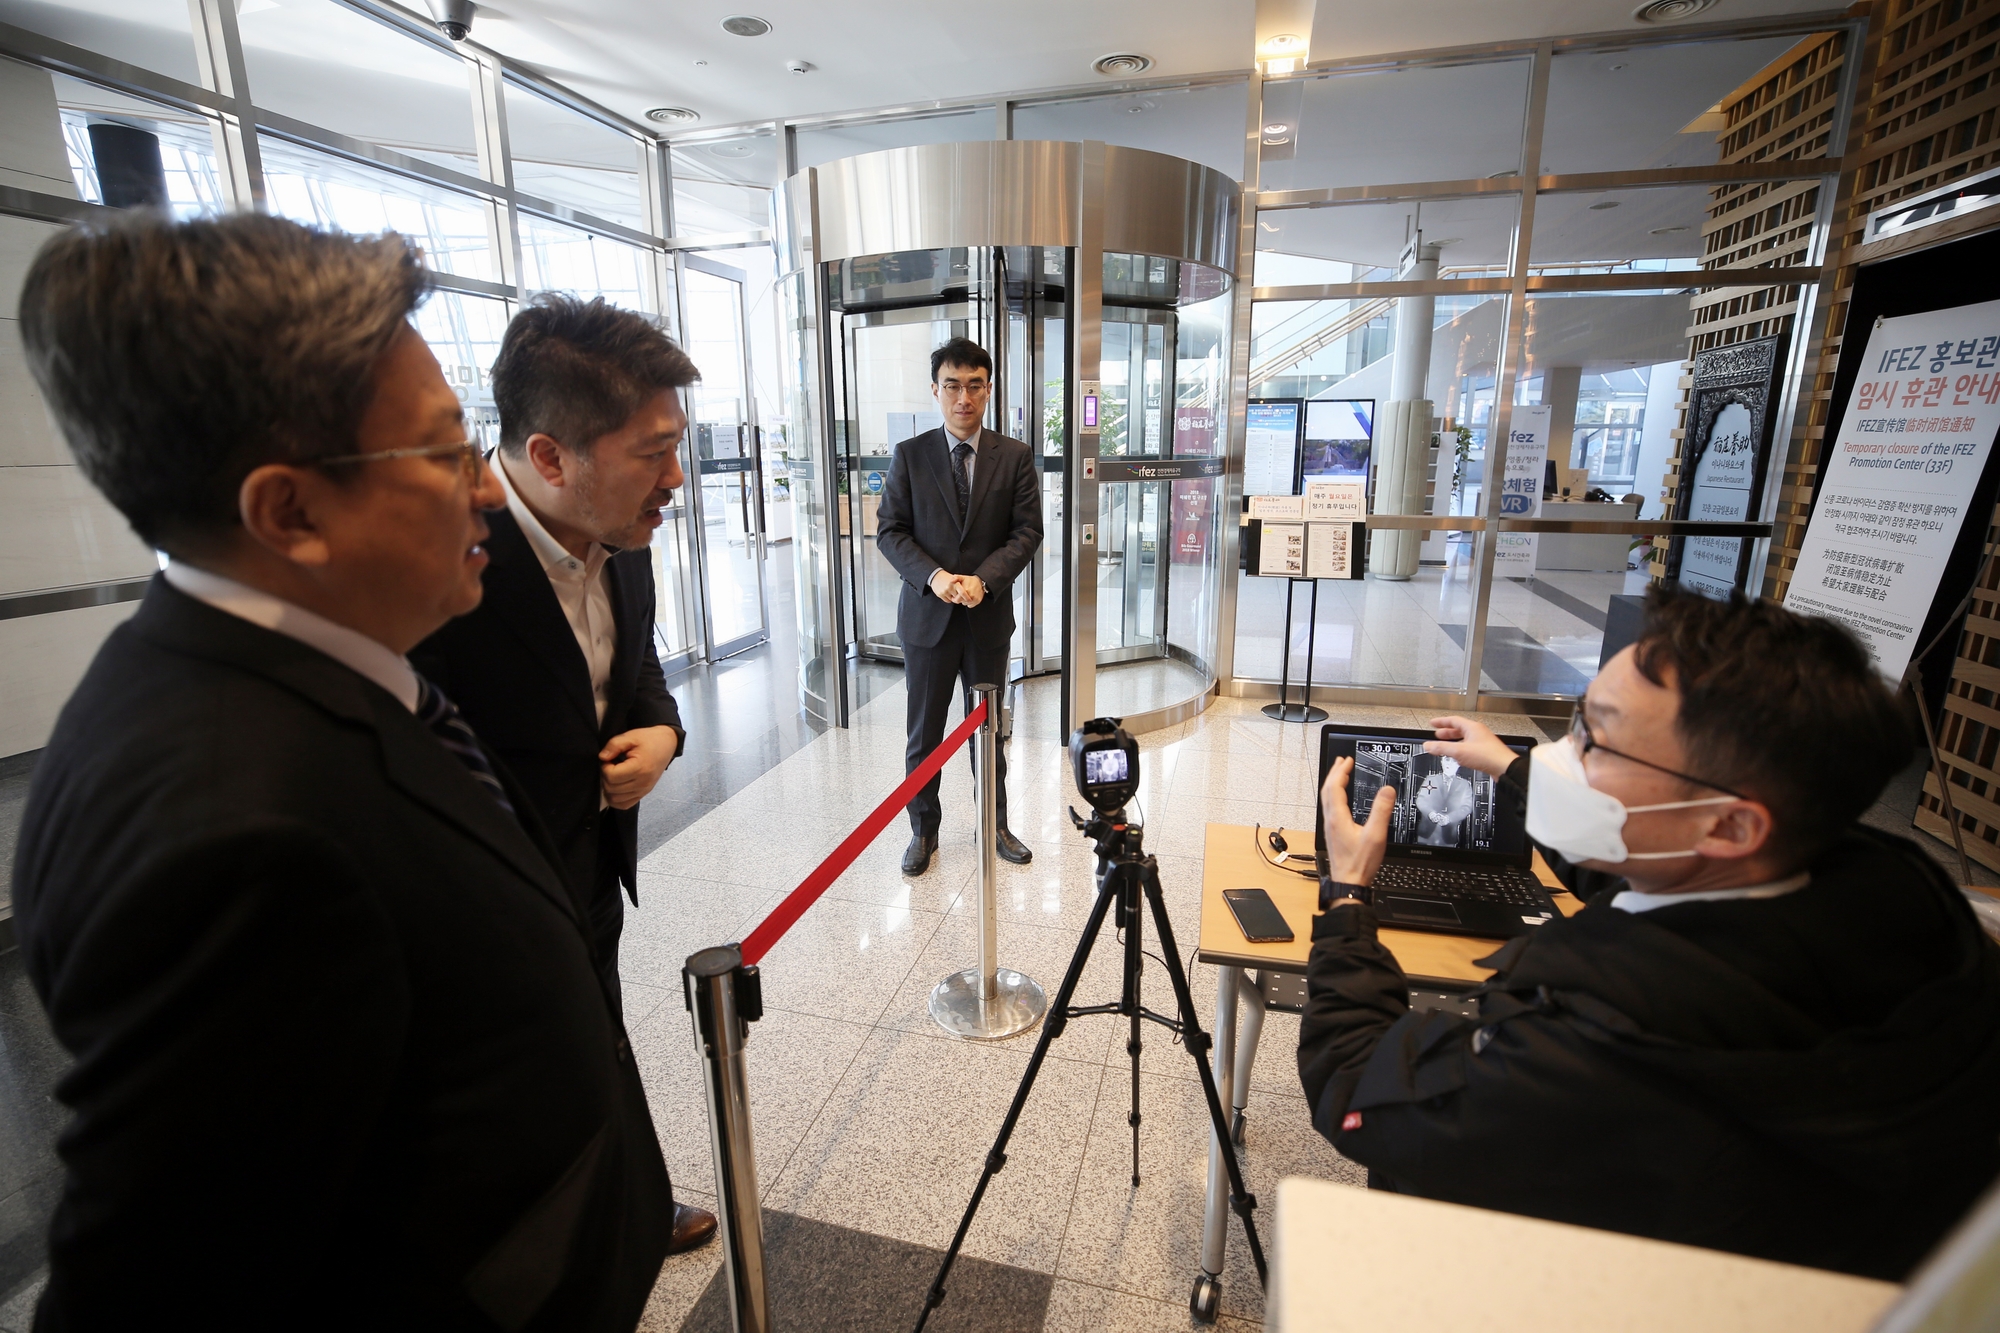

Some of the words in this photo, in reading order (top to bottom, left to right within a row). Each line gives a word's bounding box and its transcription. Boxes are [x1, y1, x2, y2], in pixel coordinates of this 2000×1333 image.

[1878, 345, 1927, 373] IFEZ
[1930, 335, 2000, 373] 홍보관
[1857, 380, 1899, 410] 임시
[1902, 377, 1948, 409] 휴관
[1953, 372, 2000, 406] 안내
[1856, 416, 1975, 433] IFEZ宣传馆临时闭馆通知
[1510, 430, 1535, 443] fez
[1843, 442, 1886, 456] Temporary
[1887, 442, 1919, 454] closure
[1921, 443, 1934, 455] of
[1934, 443, 1950, 455] the
[1951, 443, 1977, 456] IFEZ
[1506, 456, 1539, 465] /영종/청라
[1849, 457, 1892, 469] Promotion
[1893, 458, 1924, 471] Center
[1925, 459, 1953, 474] (33F)
[1138, 465, 1156, 477] ifez
[1706, 474, 1724, 484] Japanese
[1724, 475, 1745, 484] Restaurant
[1502, 478, 1537, 493] R체험
[1501, 498, 1522, 511] VR
[1824, 494, 1836, 504] 신종
[1836, 495, 1853, 505] 코로나
[1853, 497, 1876, 508] 바이러스
[1879, 499, 1897, 511] 감염증
[1898, 501, 1912, 512] 확산
[1912, 503, 1932, 515] 방지를
[1933, 505, 1958, 518] 위하여
[1824, 508, 1841, 519] 안정화
[1841, 510, 1859, 521] 시까지
[1860, 512, 1878, 523] 아래와
[1878, 514, 1892, 526] 같이
[1892, 516, 1906, 529] 잠정
[1906, 518, 1921, 530] 휴관
[1921, 520, 1944, 533] 하오니
[1496, 537, 1531, 546] CHEON
[1835, 523, 1846, 533] 적극
[1846, 525, 1870, 537] 협조하여
[1870, 529, 1890, 541] 주시기
[1890, 531, 1917, 545] 바랍니다.
[1797, 594, 1825, 609] precautionary
[1825, 603, 1843, 613] measure
[1844, 607, 1854, 616] due
[1853, 610, 1859, 618] to
[1859, 611, 1868, 620] the
[1867, 614, 1881, 624] novel
[1881, 618, 1913, 633] coronavirus
[1802, 605, 1826, 618] temporarily
[1841, 616, 1851, 625] the
[1851, 618, 1861, 628] IFEZ
[1861, 621, 1886, 635] Promotion
[1886, 628, 1906, 641] Center
[1371, 744, 1391, 753] 30.0
